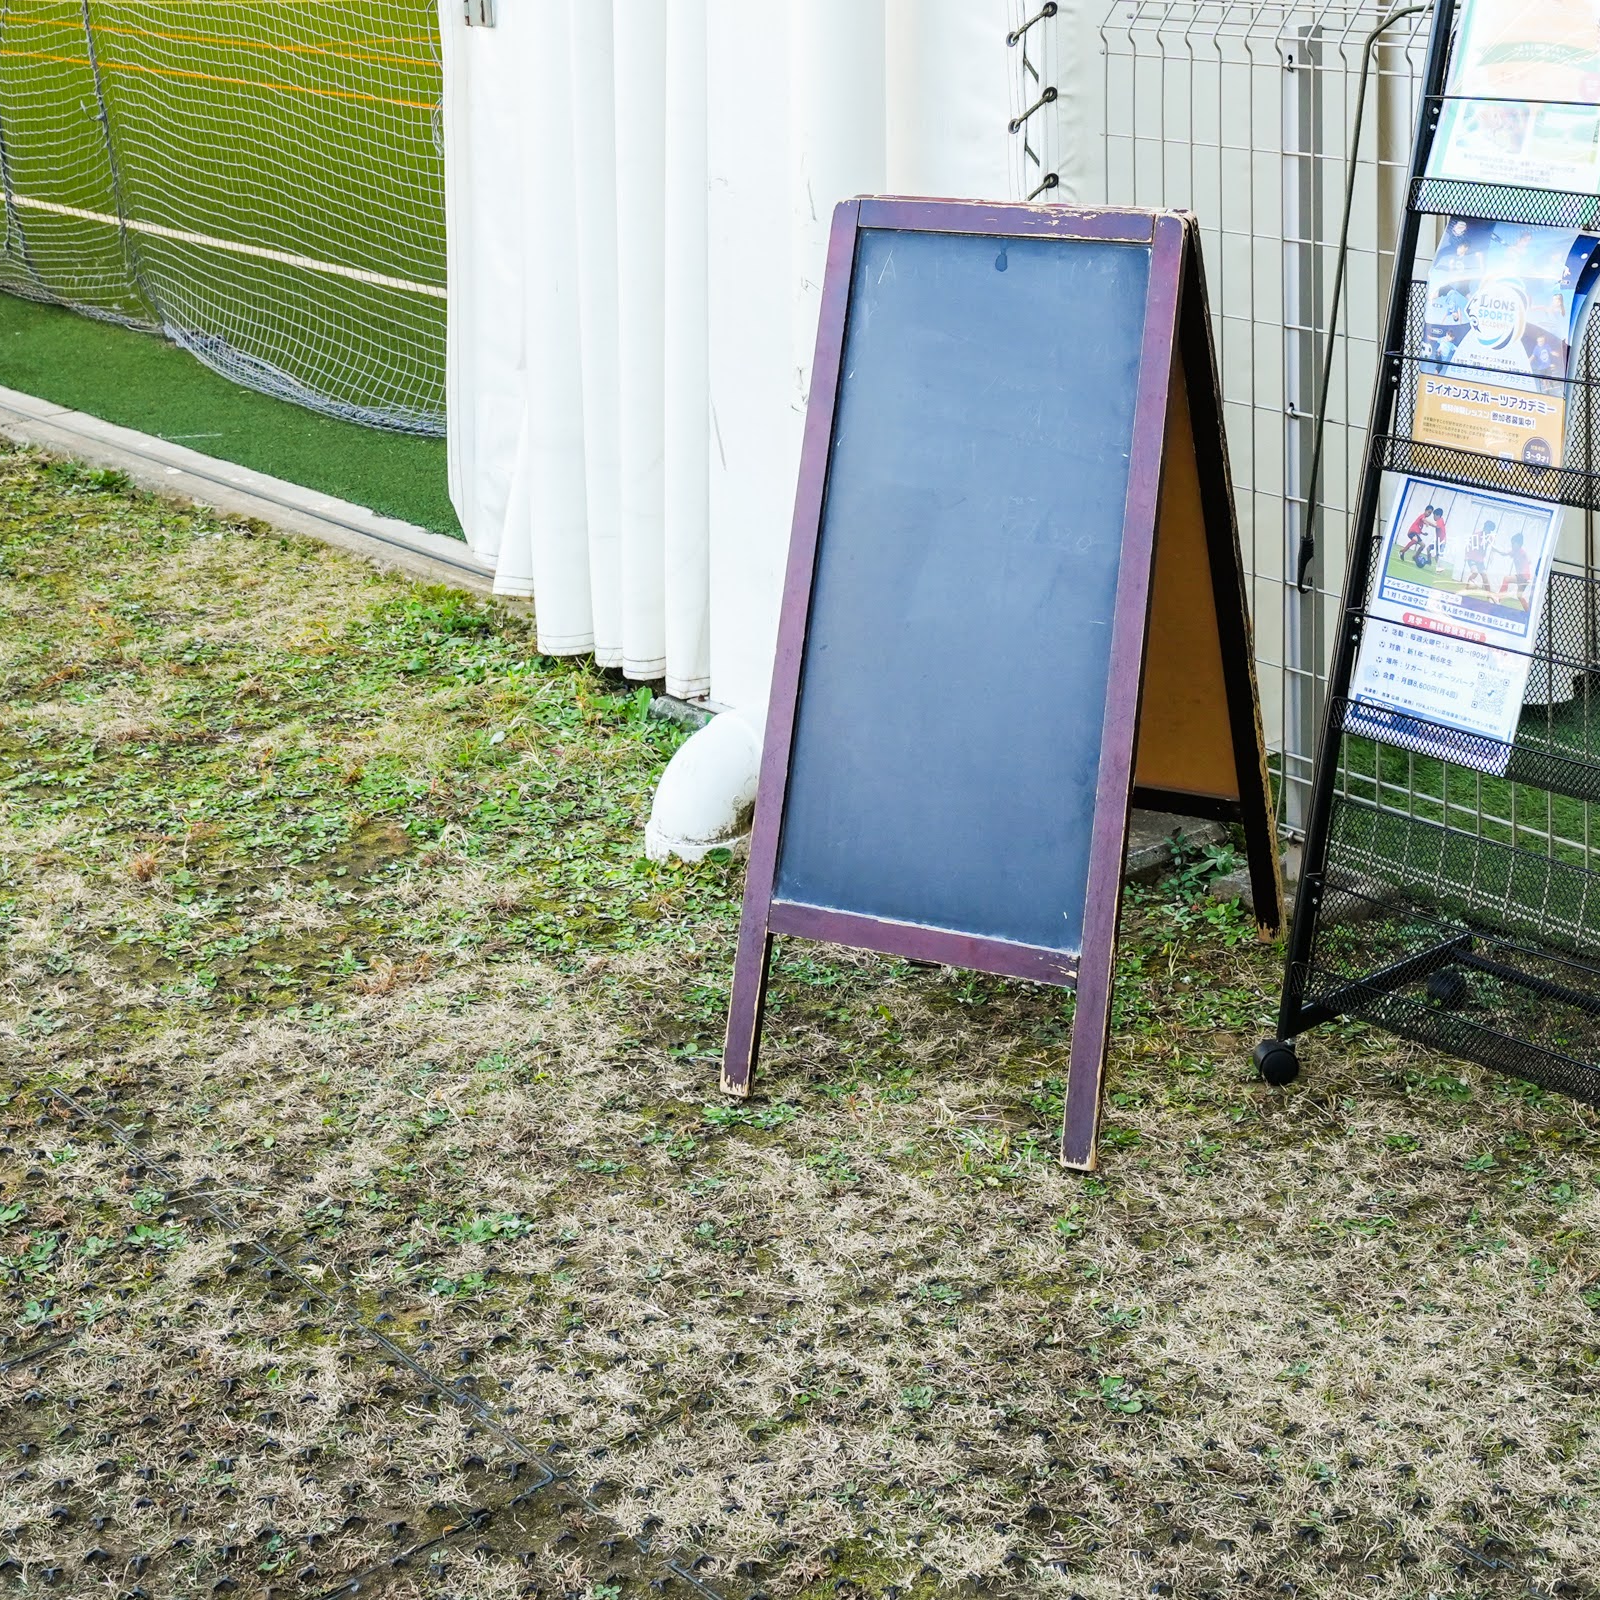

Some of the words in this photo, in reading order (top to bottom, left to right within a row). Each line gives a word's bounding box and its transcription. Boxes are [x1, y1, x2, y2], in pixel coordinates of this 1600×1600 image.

[1478, 309, 1514, 323] SPORTS
[1426, 381, 1556, 414] ライオンズスポーツアカデミー
[1491, 411, 1535, 429] 参加者募集中!
[1425, 530, 1498, 557] 北和校
